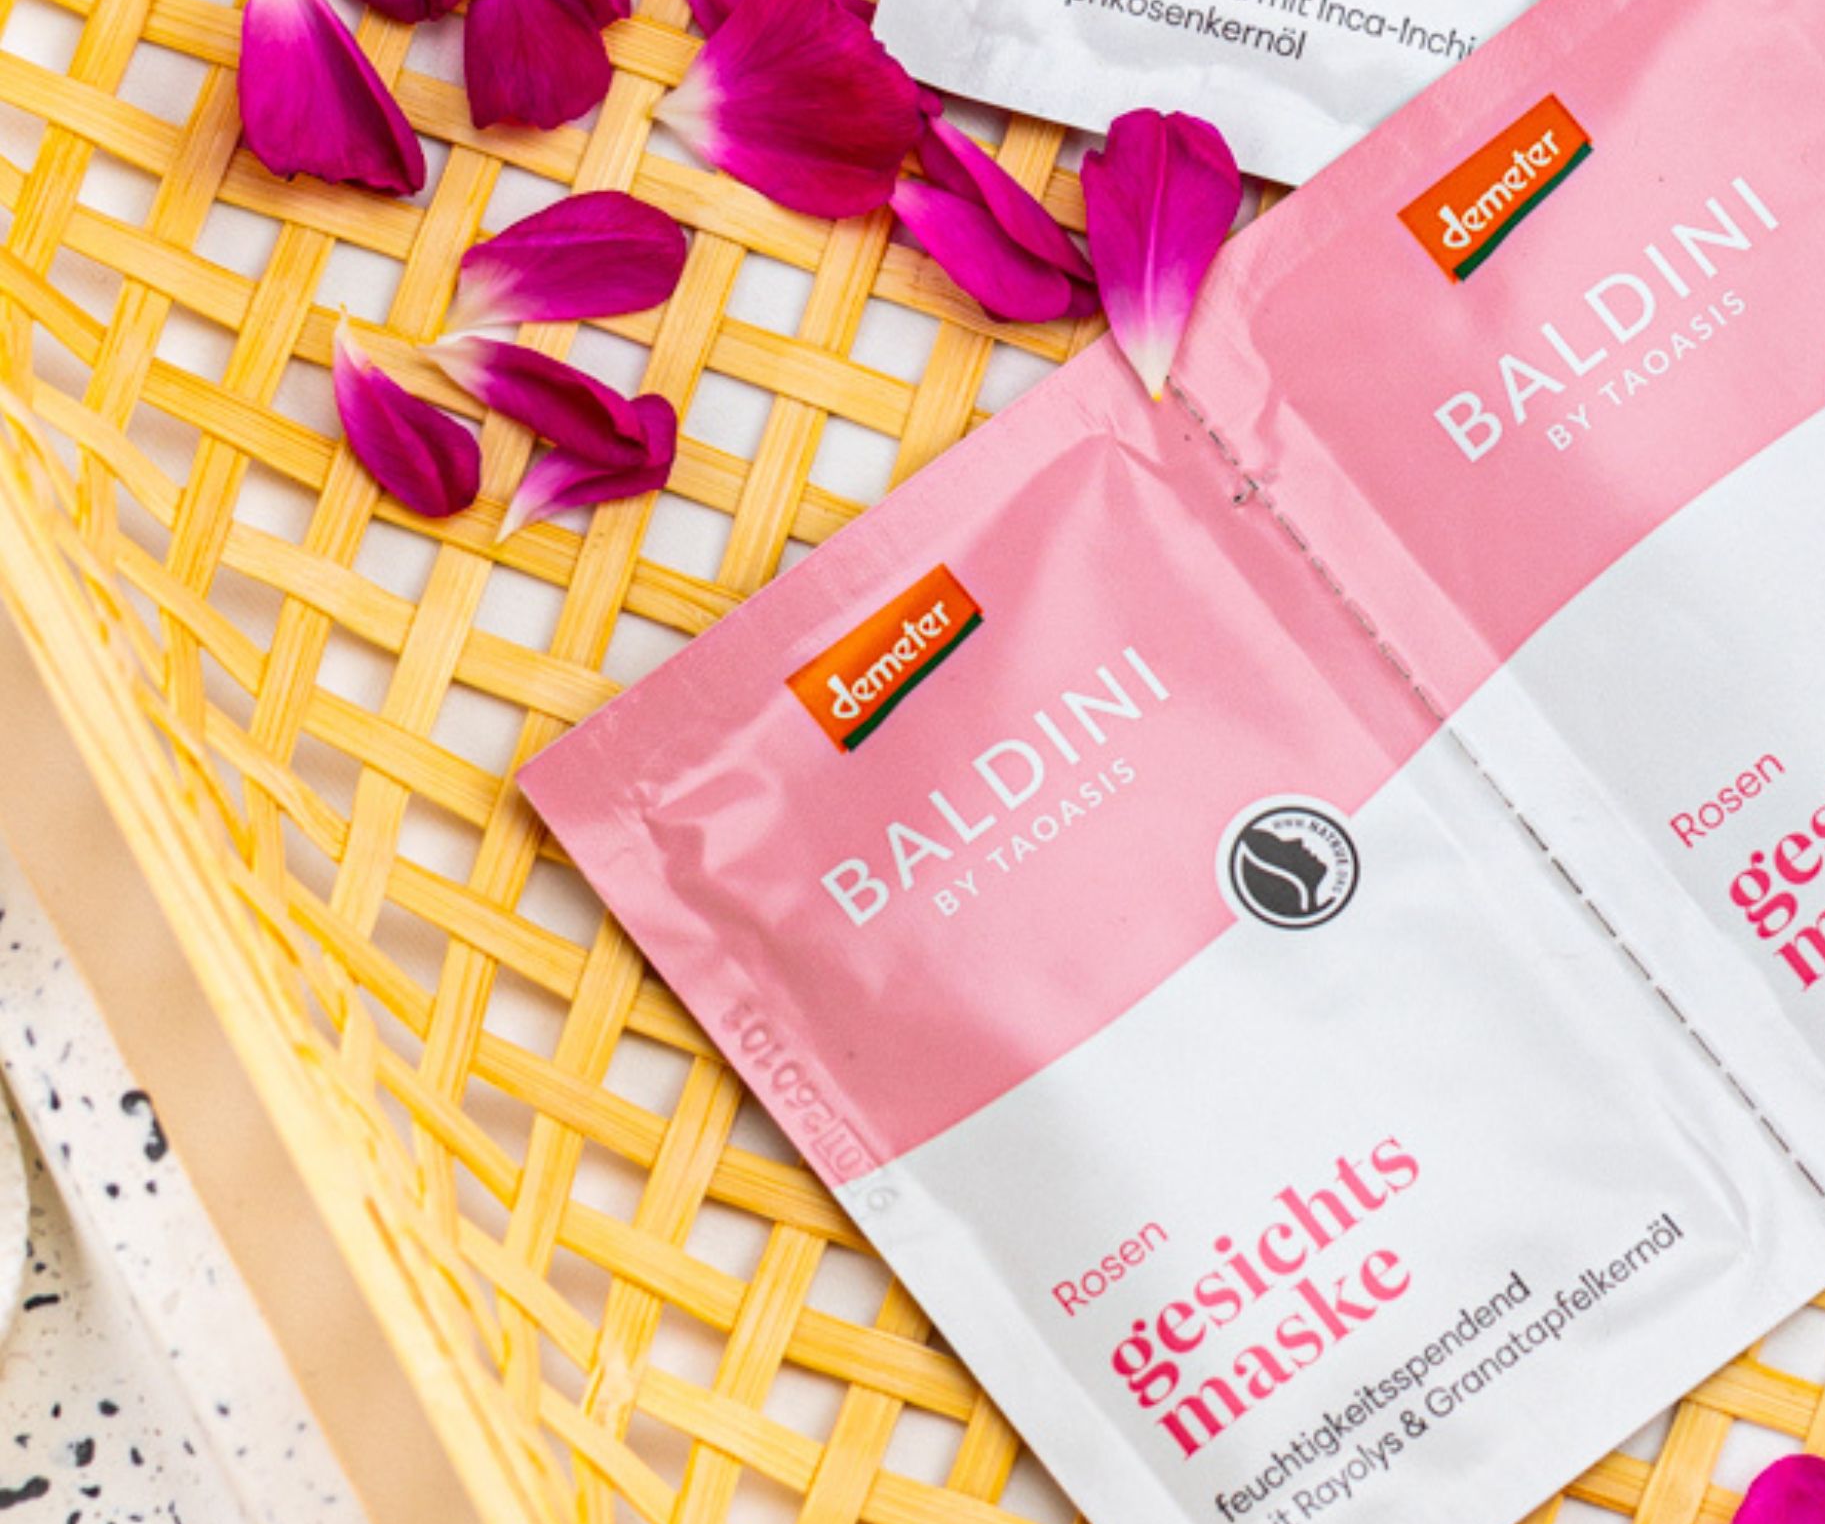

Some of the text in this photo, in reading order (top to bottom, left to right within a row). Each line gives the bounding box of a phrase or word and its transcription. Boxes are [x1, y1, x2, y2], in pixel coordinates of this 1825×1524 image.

[1441, 128, 1560, 251] demeter
[1433, 176, 1780, 463] BALDINI
[1546, 290, 1749, 452] BY TAOASIS
[831, 601, 951, 720] demeter
[820, 646, 1170, 927] BALDINI
[933, 758, 1137, 918] BY TAOASIS
[1668, 752, 1786, 849] Rosen
[1051, 1219, 1169, 1318] Rosen
[1110, 1136, 1420, 1410] gesichts
[1155, 1249, 1413, 1460] maske
[1215, 1271, 1531, 1524] feuchtigkeitsspendend
[1292, 1431, 1404, 1522] Rayolys
[1400, 1410, 1428, 1437] &
[1425, 1212, 1684, 1417] Granatapfelkernöl
